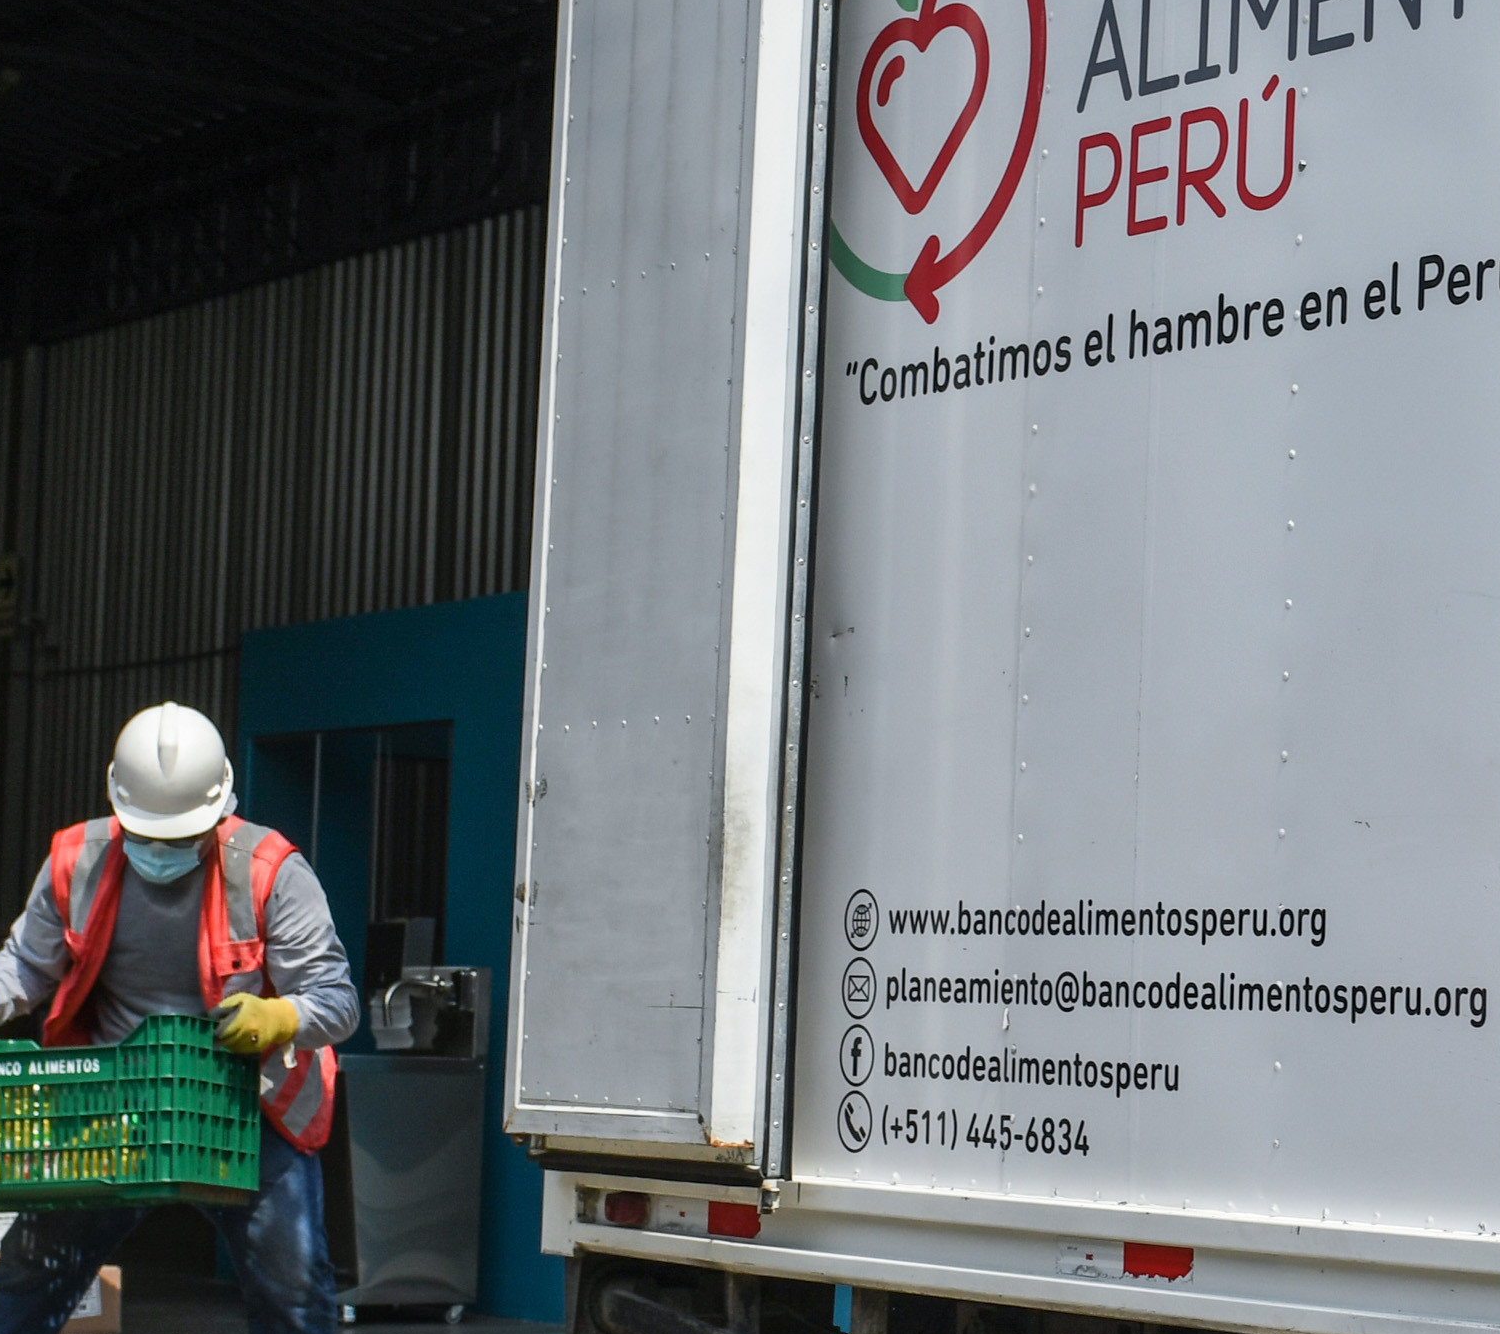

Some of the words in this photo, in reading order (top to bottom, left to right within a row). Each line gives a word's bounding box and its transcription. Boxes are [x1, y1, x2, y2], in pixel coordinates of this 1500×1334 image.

[1074, 73, 1297, 248] PERÚ
[1083, 321, 1115, 368] el
[1129, 291, 1285, 360] hambre
[1300, 284, 1347, 332] en
[1364, 261, 1400, 320] el
[889, 899, 1327, 947] www.bancodealimentosperu.org
[885, 967, 1488, 1027] planeamiento@bancodealimentosperu.org
[28, 1057, 100, 1076] ALIMENTOS
[883, 1043, 1180, 1097] bancodealimentosperu
[881, 1107, 957, 1151] (+511)
[966, 1111, 1090, 1157] 445-6834
